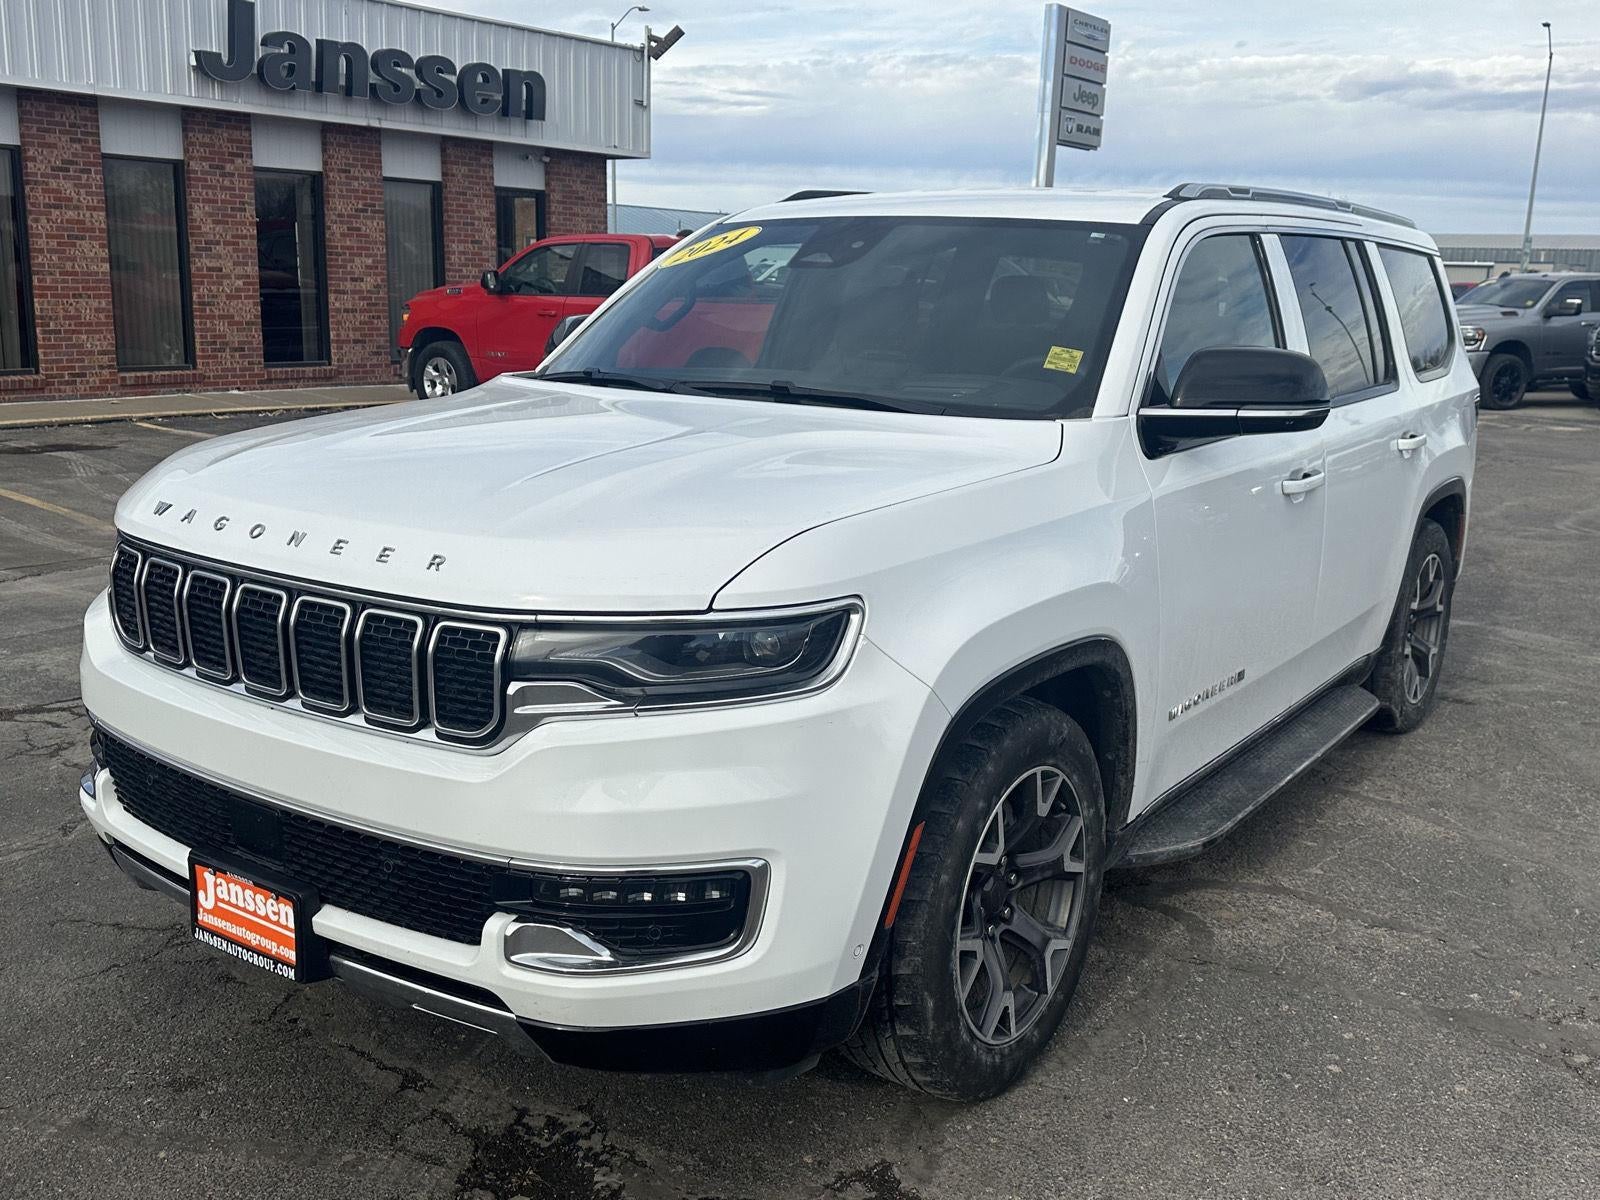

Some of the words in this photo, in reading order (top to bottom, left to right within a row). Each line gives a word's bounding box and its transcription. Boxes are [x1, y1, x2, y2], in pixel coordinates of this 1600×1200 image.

[191, 0, 546, 121] Janssen
[1069, 55, 1106, 74] DODGE
[1073, 84, 1099, 110] Jeep
[1076, 122, 1101, 137] RAM
[153, 500, 447, 572] WAGONEER
[198, 871, 295, 929] Janssen
[197, 908, 296, 960] Janssenautogroup.com
